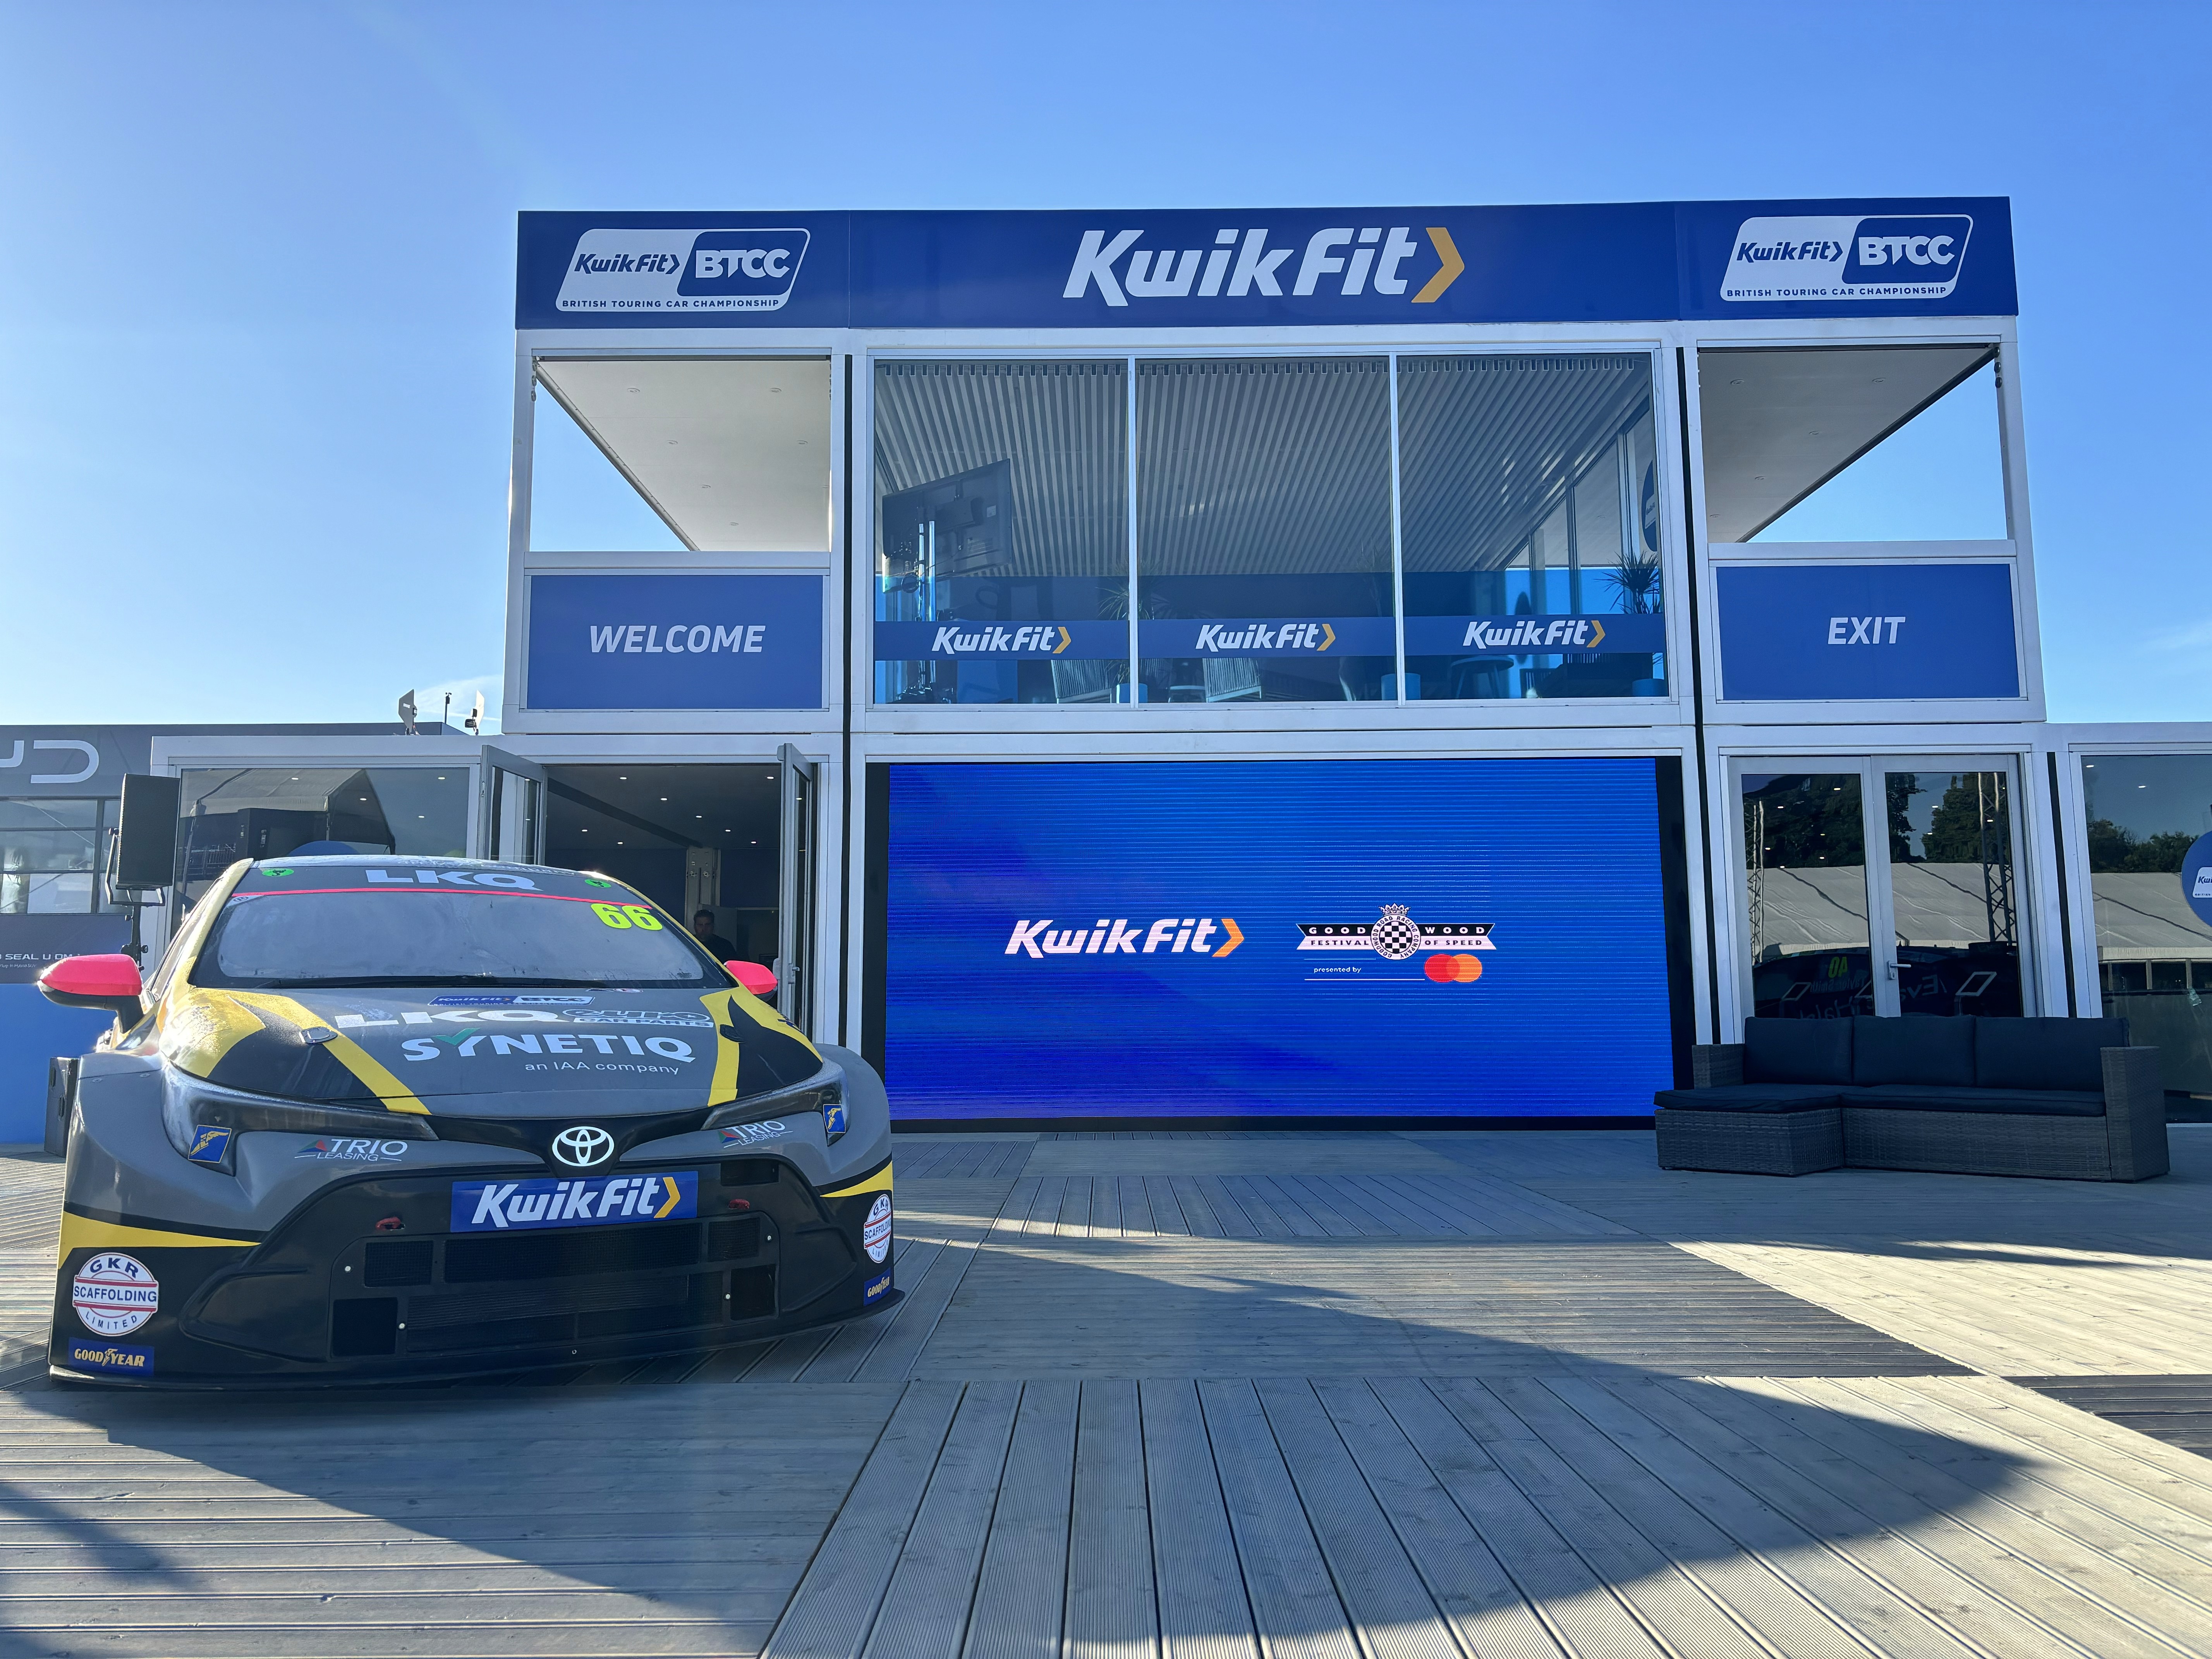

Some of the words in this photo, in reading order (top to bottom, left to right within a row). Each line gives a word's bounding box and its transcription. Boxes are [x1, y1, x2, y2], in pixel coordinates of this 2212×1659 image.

[1859, 235, 1954, 265] BTCC
[696, 249, 790, 278] BTCC
[591, 625, 766, 653] WELCOME
[1828, 617, 1905, 644] EXIT
[367, 869, 544, 891] LKQ
[591, 903, 663, 930] 66
[1377, 916, 1393, 927] ROAD
[1396, 916, 1417, 932] RACING
[1400, 935, 1419, 958] COMPANY
[335, 1010, 571, 1028] LKQ
[402, 1029, 696, 1063] SYNETIQ
[554, 1061, 590, 1070] IAA
[596, 1064, 679, 1075] company
[725, 1121, 785, 1138] TRIO
[738, 1132, 781, 1146] LEASING
[317, 1152, 379, 1162] LEASING
[330, 1139, 408, 1156] TRIO
[90, 1257, 139, 1279] GKR
[74, 1285, 157, 1302] SCAFFOLDING
[85, 1310, 137, 1330] LIMITED
[74, 1348, 145, 1367] GOODYEAR
